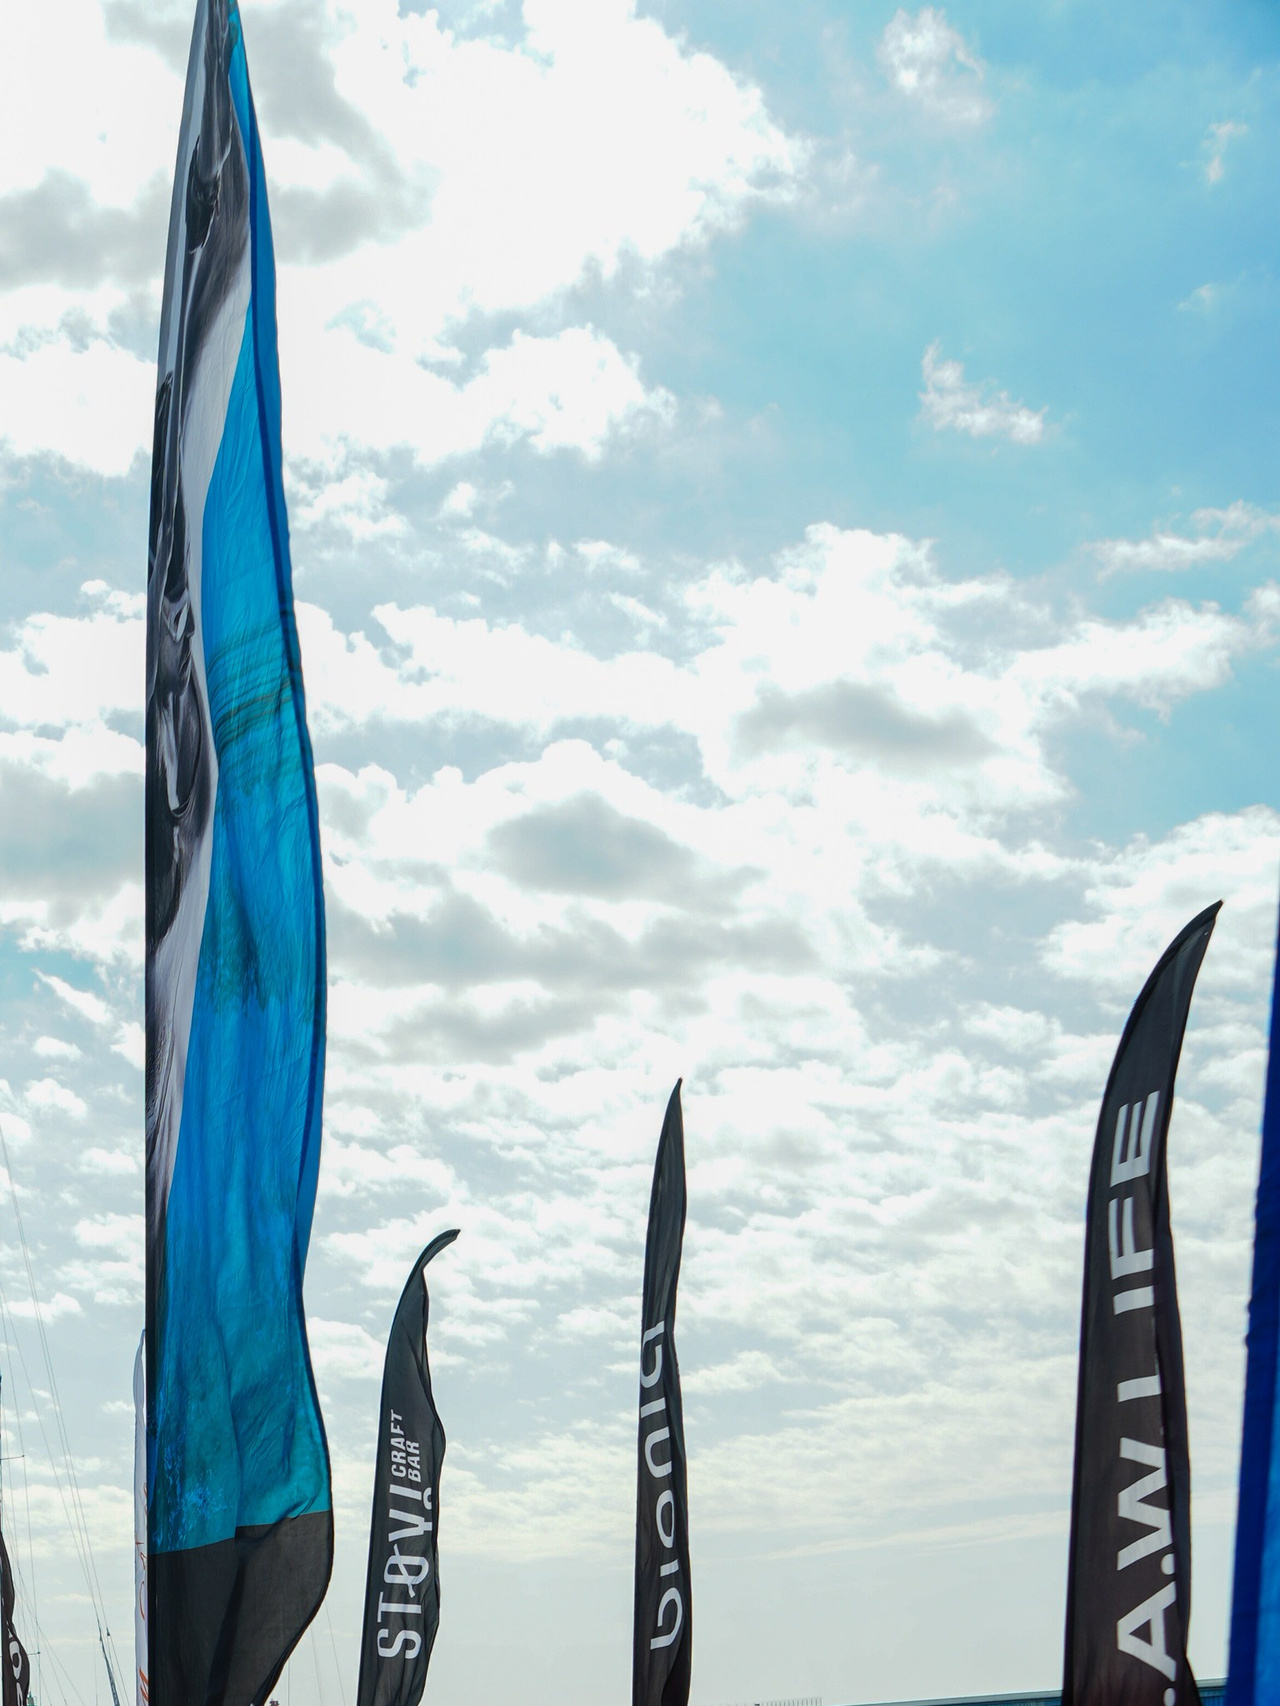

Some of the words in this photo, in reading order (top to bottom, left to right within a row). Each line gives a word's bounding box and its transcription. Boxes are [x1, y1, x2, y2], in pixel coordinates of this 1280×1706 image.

[390, 1409, 406, 1477] CRAFT
[406, 1440, 421, 1482] BAR
[640, 1320, 684, 1651] bioniq
